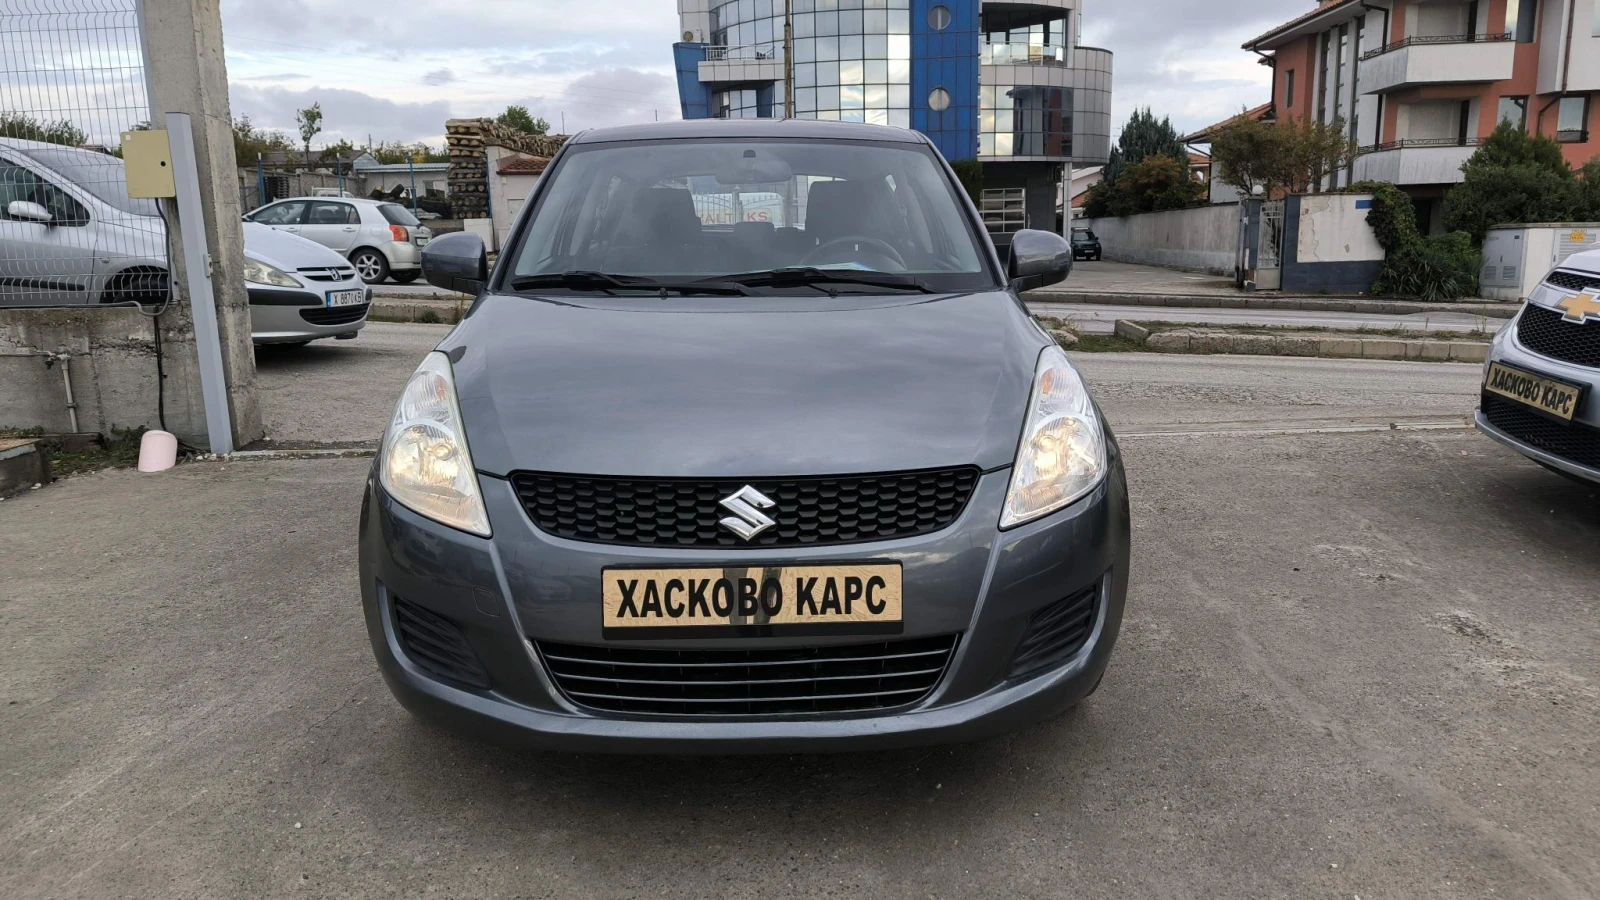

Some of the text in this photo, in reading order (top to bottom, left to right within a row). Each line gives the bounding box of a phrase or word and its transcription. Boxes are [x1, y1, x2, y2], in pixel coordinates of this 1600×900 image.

[1490, 368, 1572, 415] ХАСКОВО КАРС
[617, 575, 887, 618] ХАСКОВО КАРС
